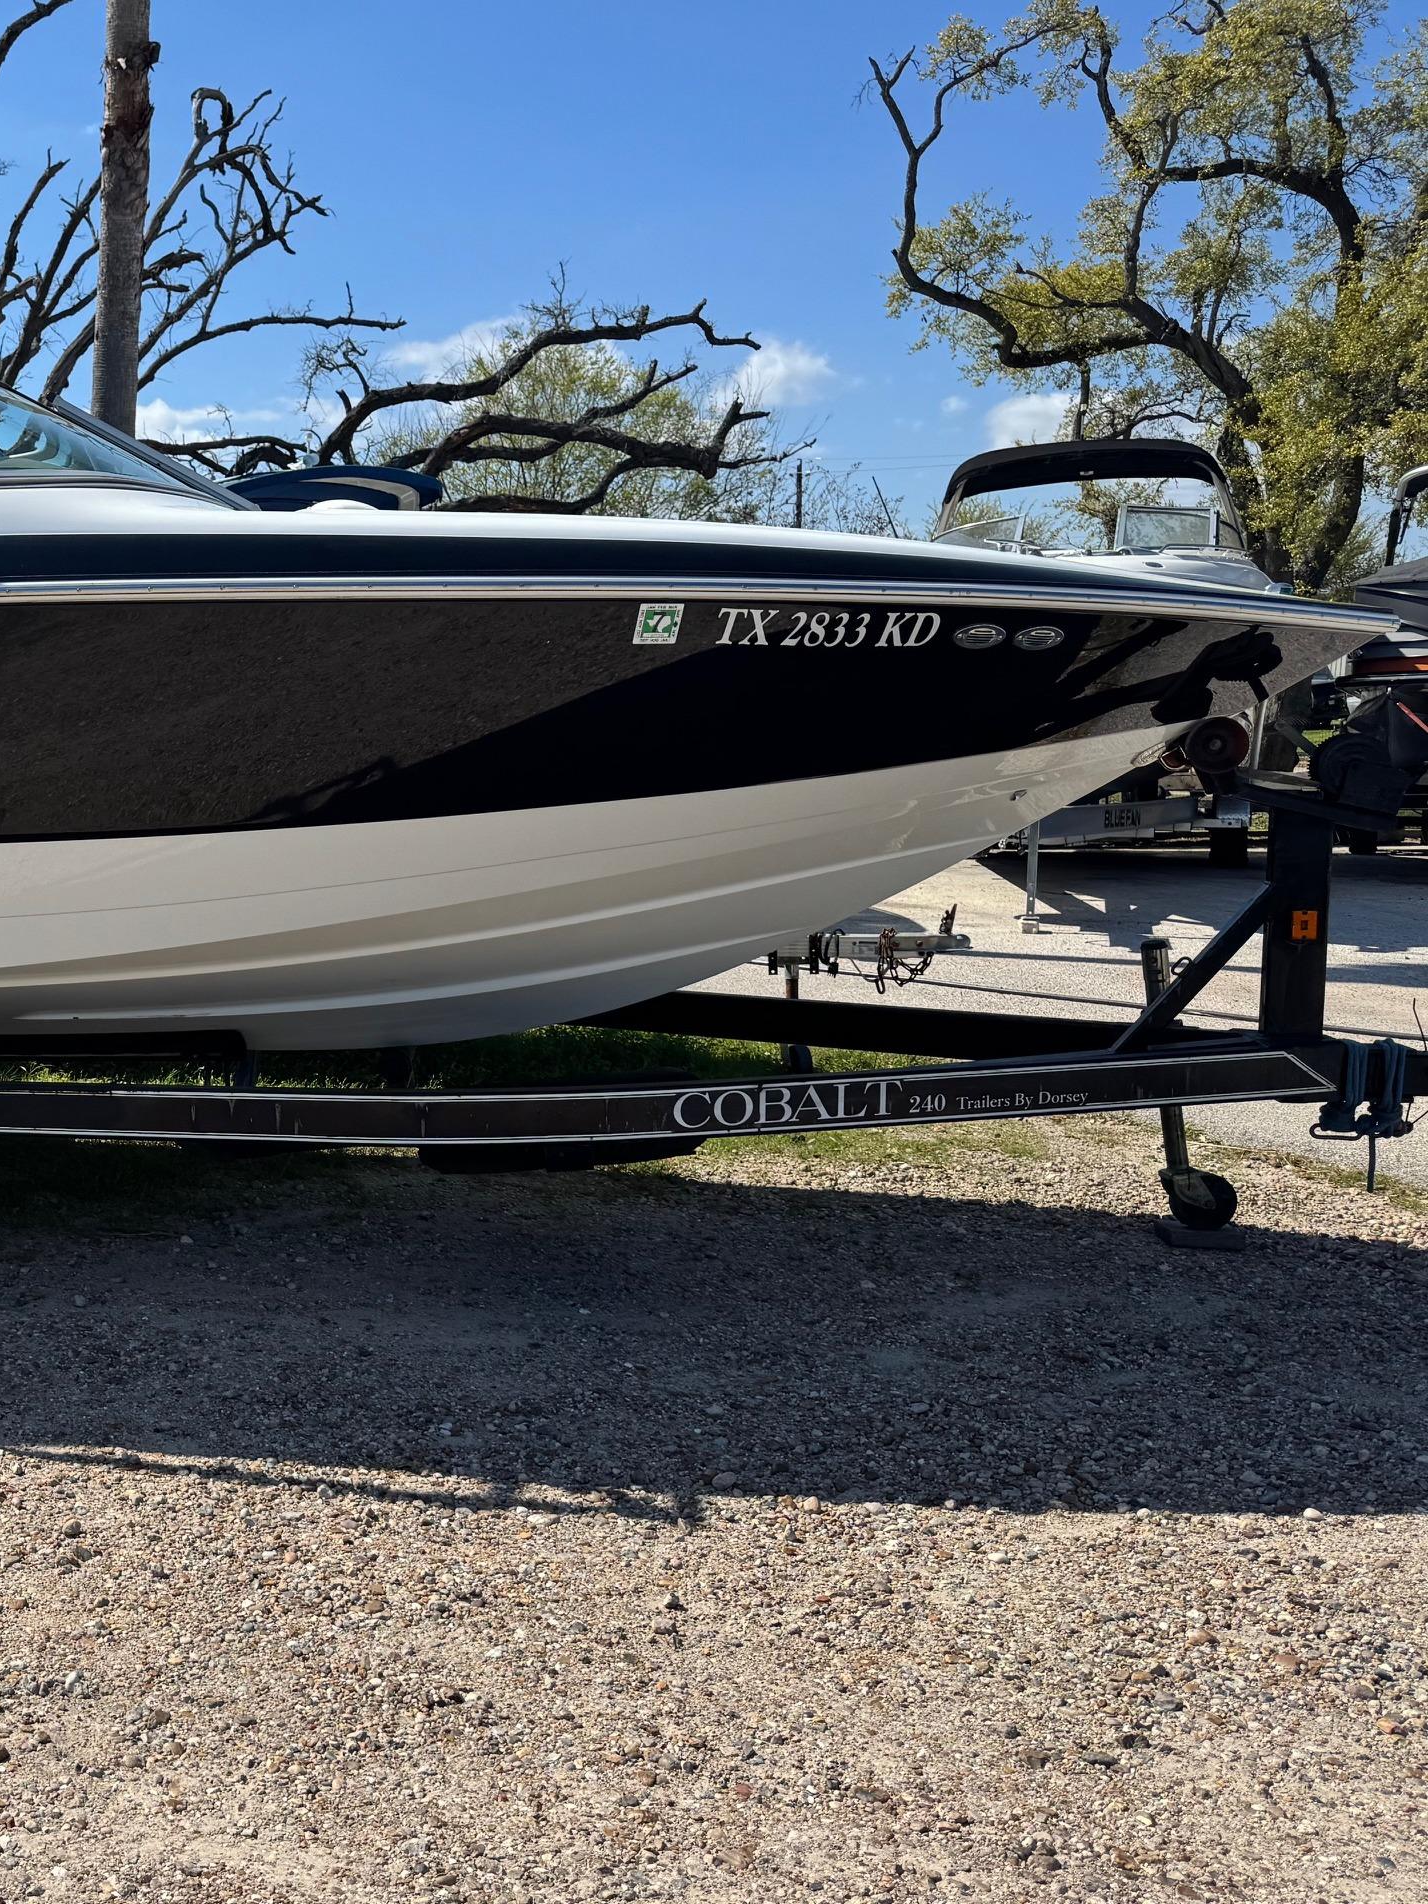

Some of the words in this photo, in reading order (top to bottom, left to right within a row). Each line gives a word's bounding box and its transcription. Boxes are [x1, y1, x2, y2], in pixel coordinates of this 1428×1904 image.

[715, 607, 780, 646] TX
[780, 611, 871, 648] 2833
[874, 612, 941, 647] KD
[672, 1080, 903, 1129] COBALT
[909, 1093, 947, 1113] 240
[956, 1095, 1011, 1110] Trailers
[1015, 1092, 1034, 1110] By
[1038, 1090, 1089, 1106] Dorsey
